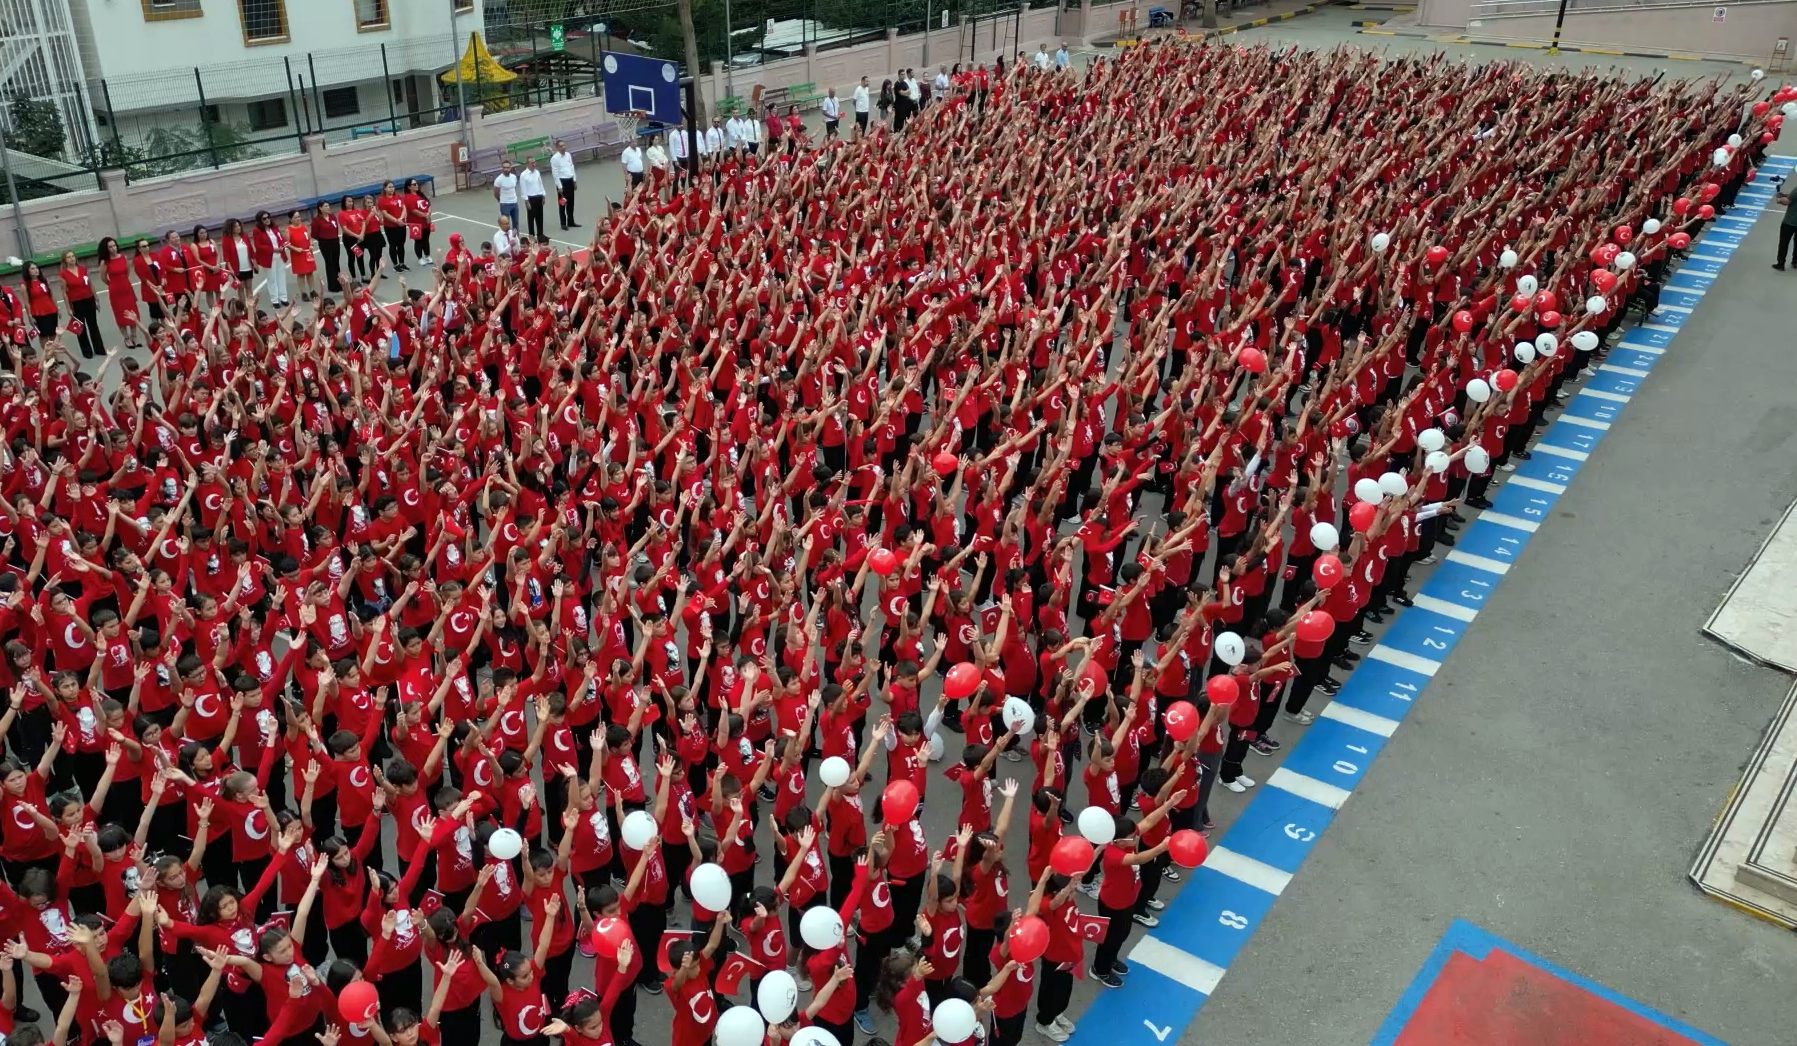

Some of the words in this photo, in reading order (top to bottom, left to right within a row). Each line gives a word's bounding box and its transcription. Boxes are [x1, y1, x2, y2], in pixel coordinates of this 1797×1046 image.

[1693, 279, 1709, 289] 24
[1665, 314, 1682, 324] 22
[1649, 333, 1669, 344] 21
[1633, 354, 1654, 367] 20
[1614, 380, 1635, 393] 19
[1594, 405, 1616, 418] 18
[1573, 434, 1594, 448] 17
[1548, 465, 1574, 481] 16
[1524, 498, 1548, 516] 15
[1494, 537, 1520, 556] 14
[1461, 579, 1490, 600] 13
[1422, 626, 1455, 650] 12
[1389, 682, 1418, 701] 11
[1332, 744, 1368, 775] 10
[1284, 823, 1316, 842] 9
[1219, 910, 1249, 930] 8
[1143, 1019, 1172, 1042] 7
